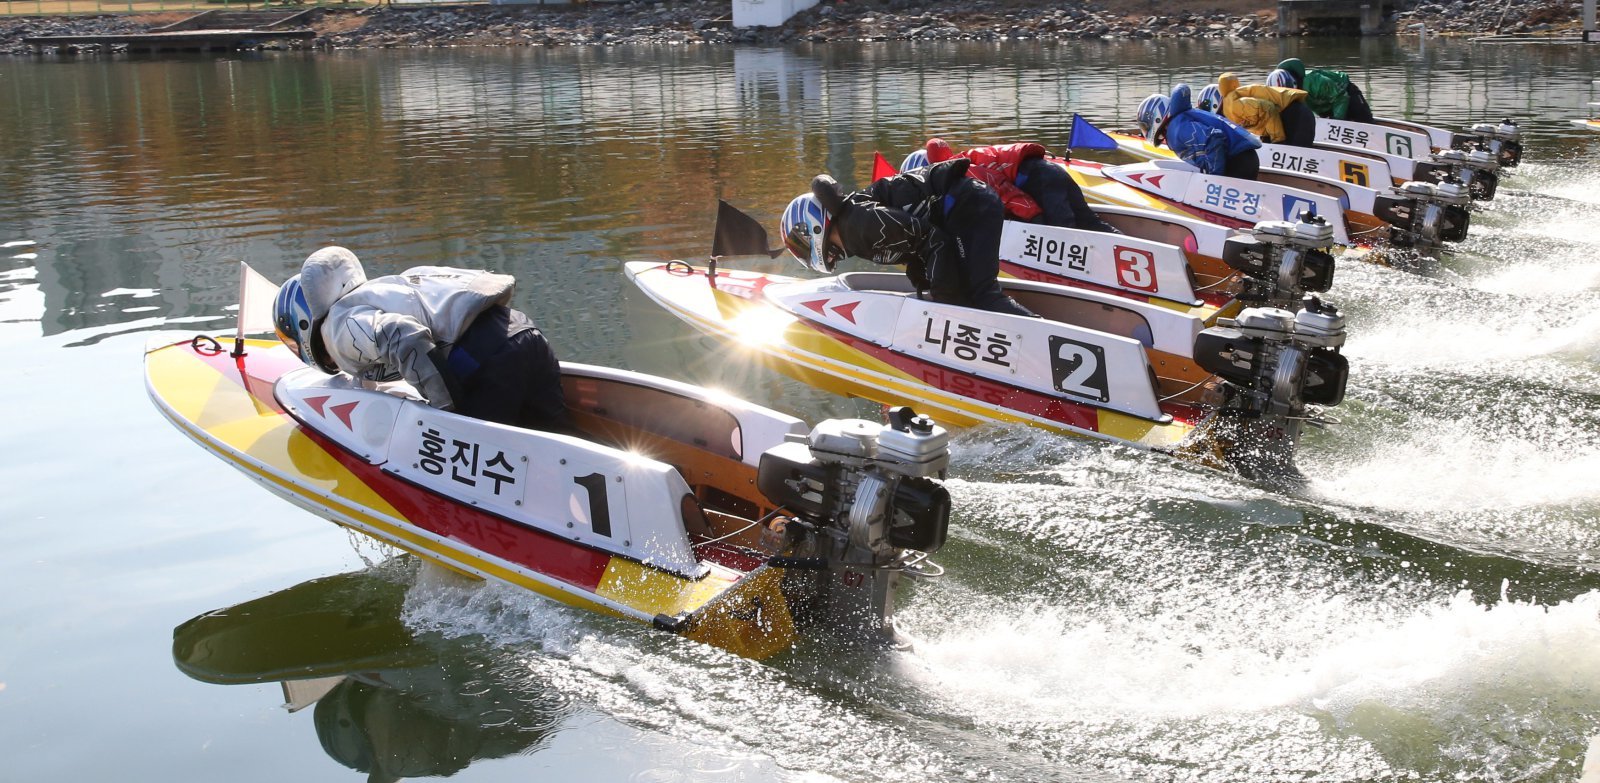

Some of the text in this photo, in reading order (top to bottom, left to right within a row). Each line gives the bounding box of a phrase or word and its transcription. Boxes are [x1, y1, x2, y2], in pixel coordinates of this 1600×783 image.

[1327, 123, 1369, 148] 전동욱
[1389, 136, 1410, 158] 6
[1344, 162, 1367, 187] 5
[1205, 183, 1260, 216] 염윤정
[1022, 234, 1089, 273] 최인원
[1119, 250, 1153, 290] 3
[924, 317, 1013, 368] 나종호
[1057, 342, 1102, 398] 2
[418, 428, 516, 496] 홍진수
[573, 472, 613, 538] 1
